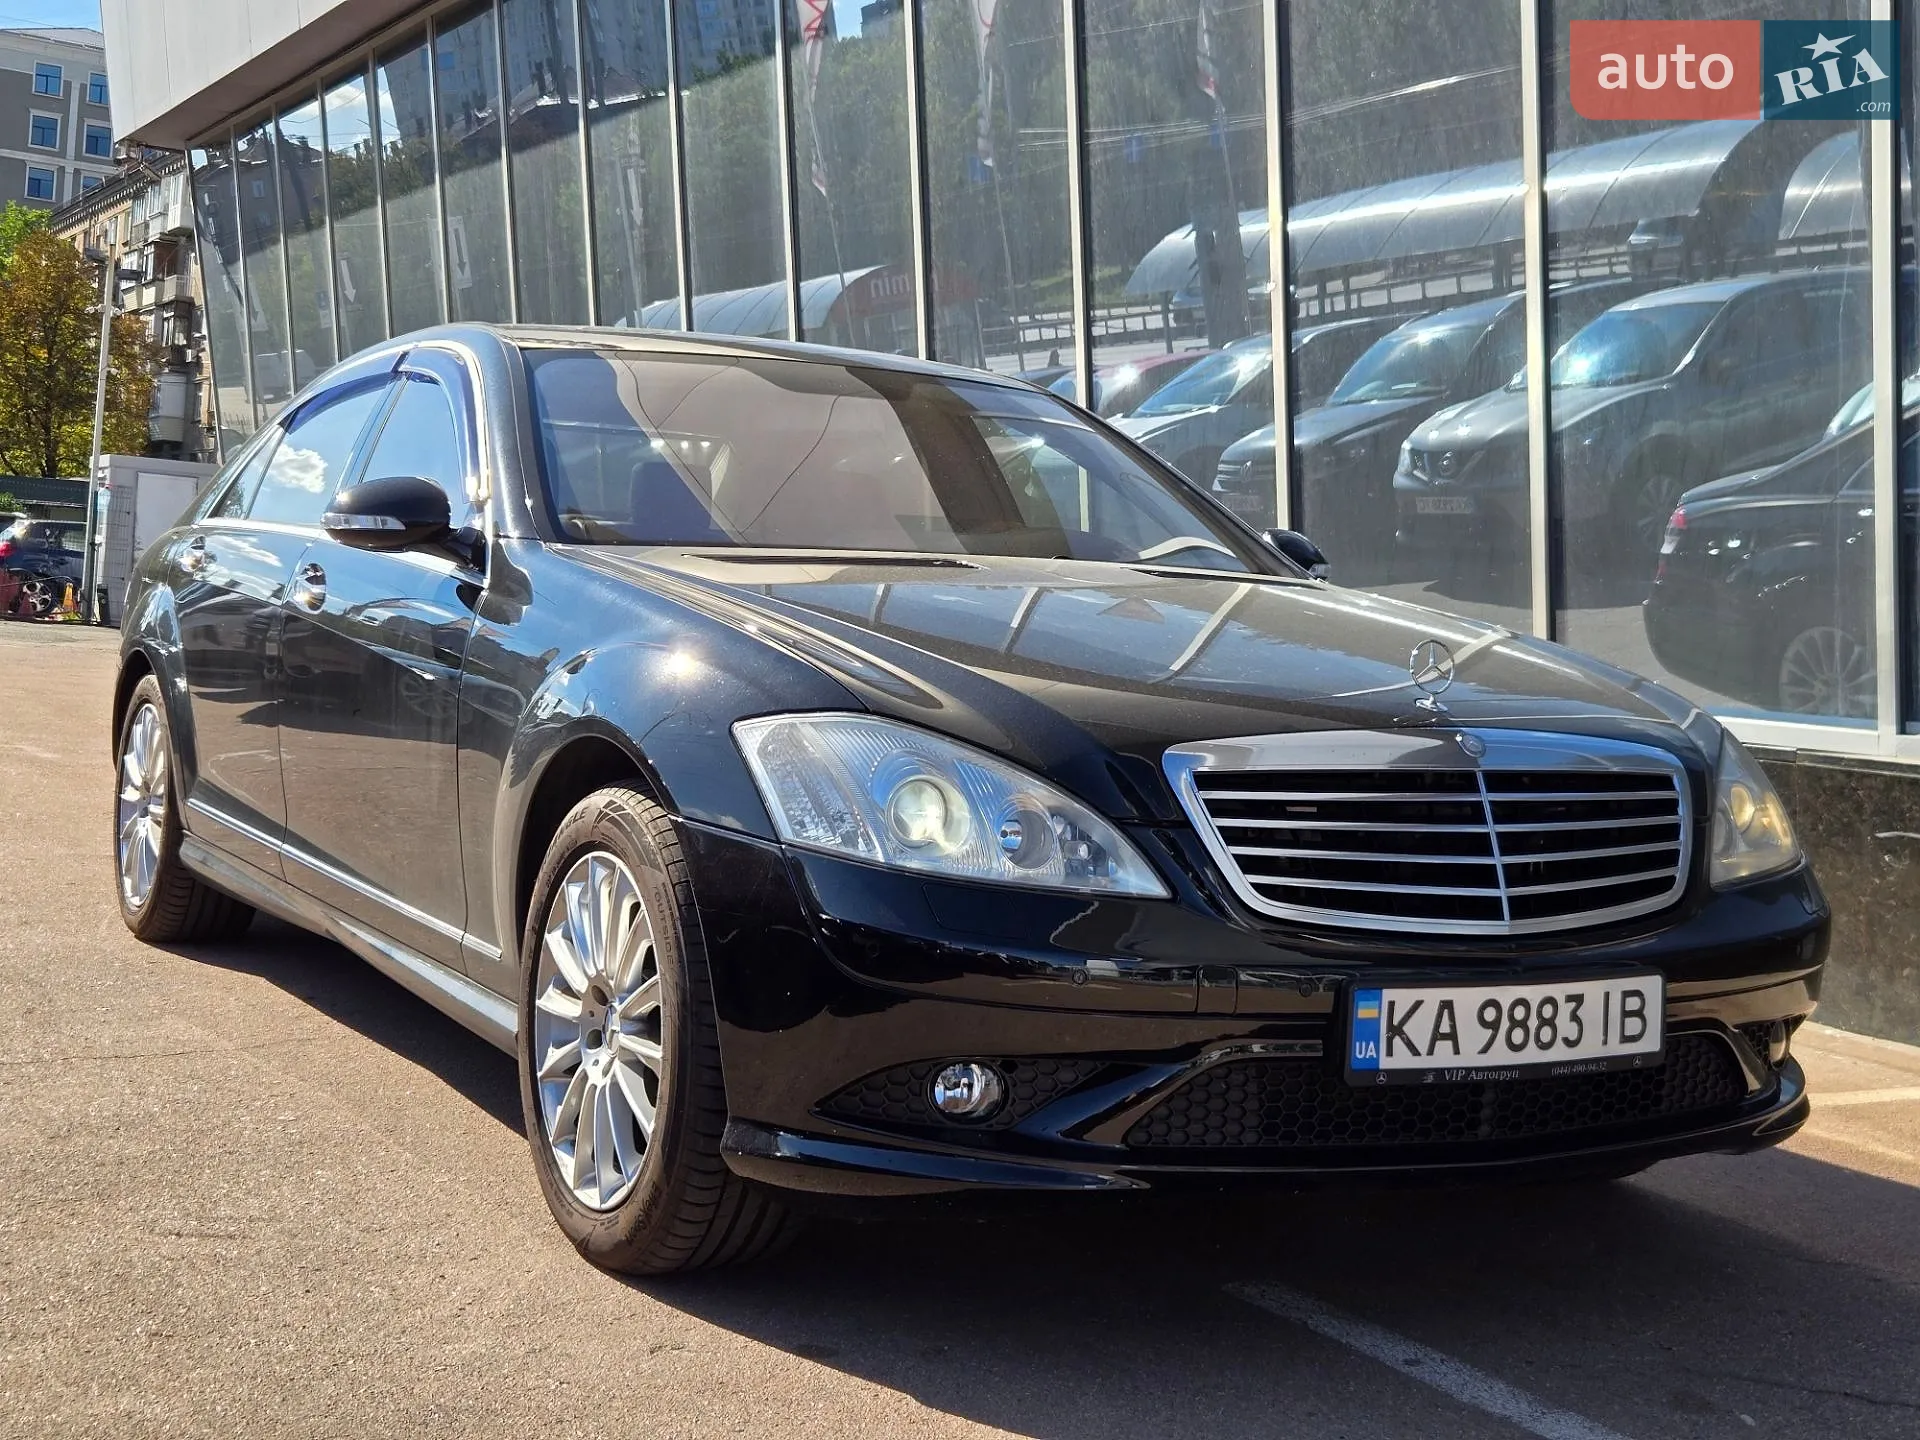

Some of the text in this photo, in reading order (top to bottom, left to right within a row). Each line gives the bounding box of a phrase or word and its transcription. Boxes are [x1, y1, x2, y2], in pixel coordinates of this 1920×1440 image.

[1385, 989, 1648, 1058] KA 9883 IB
[1356, 1041, 1377, 1059] UA
[1444, 1069, 1466, 1081] VIP
